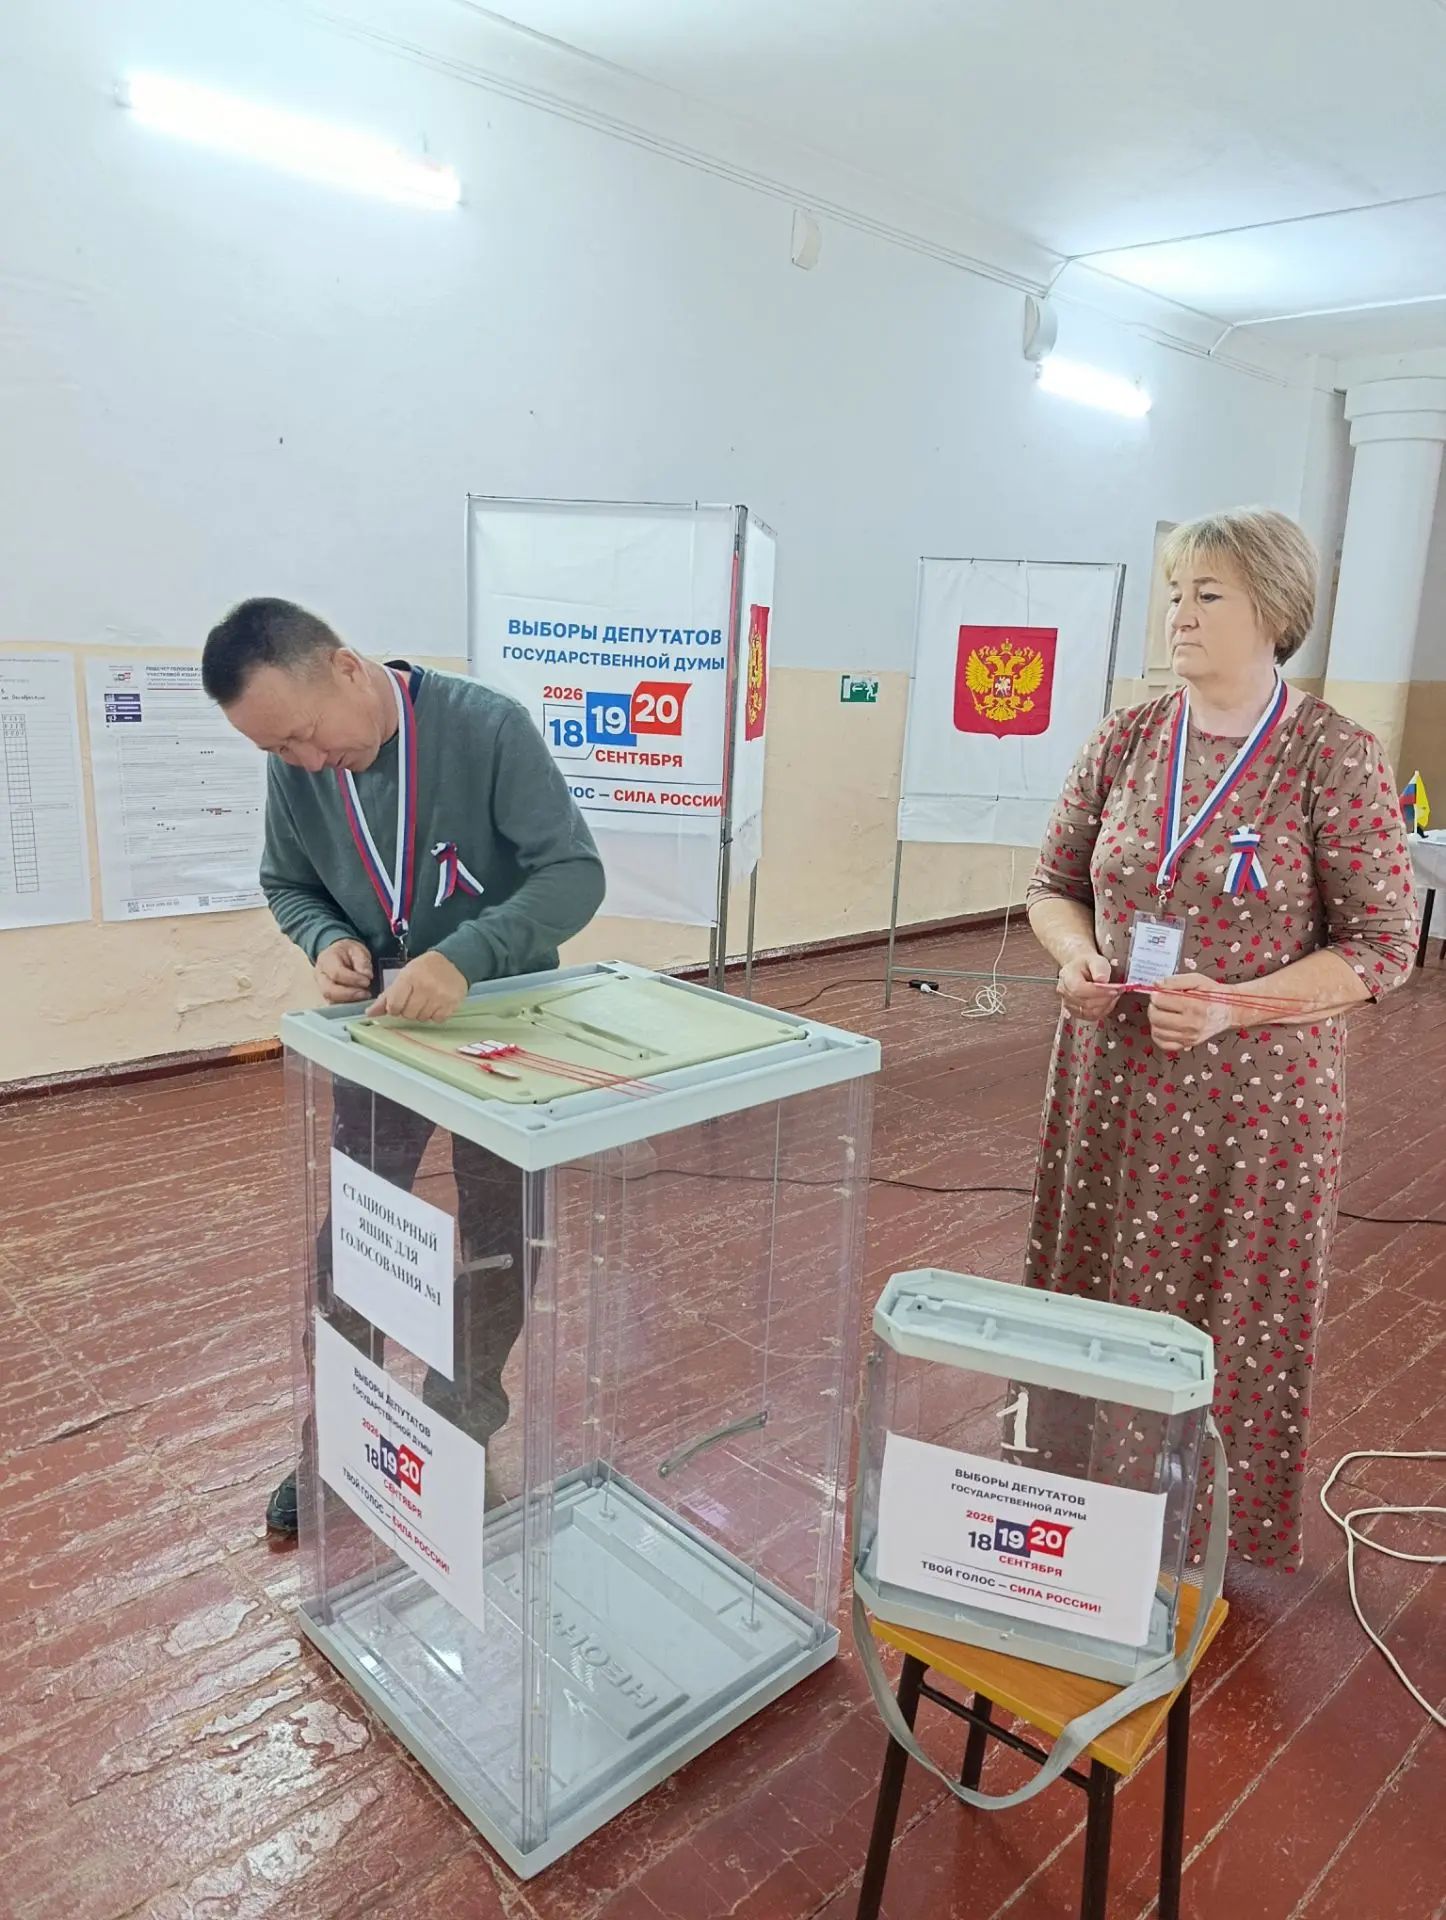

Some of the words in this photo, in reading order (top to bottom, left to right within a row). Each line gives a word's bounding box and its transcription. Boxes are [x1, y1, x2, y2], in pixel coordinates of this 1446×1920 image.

[508, 619, 597, 640] ВЫБОРЫ
[602, 626, 722, 646] ДЕПУТАТОВ
[503, 646, 670, 669] ГОСУДАРСТВЕННОЙ
[673, 656, 725, 672] ДУМЫ
[543, 686, 583, 700] 2026
[549, 719, 584, 747] 18
[591, 705, 627, 735] 19
[635, 694, 679, 723] 20
[595, 750, 683, 767] СЕНТЯБРЯ
[614, 789, 656, 804] СИЛА
[342, 1183, 438, 1252] СТАЦИОНАРНЫЙ
[359, 1217, 394, 1250] ЯЩИК
[394, 1240, 419, 1265] ДЛЯ
[340, 1227, 422, 1292] ГОЛОСОВАНИЯ
[424, 1284, 441, 1306] №1
[353, 1383, 411, 1438] ГОСУДАРСТВЕННОЙ
[412, 1435, 433, 1456] ДУМЫ
[354, 1367, 384, 1400] ВЫБОРЫ
[386, 1394, 431, 1437] ДЕПУТАТОВ
[362, 1418, 379, 1438] 2026
[996, 1391, 1039, 1453] 1
[364, 1443, 380, 1471] 18
[382, 1447, 398, 1475] 19
[400, 1452, 420, 1484] 20
[343, 1467, 361, 1489] ТВОЙ
[361, 1486, 384, 1514] ГОЛОС
[392, 1515, 413, 1541] СИЛА
[384, 1479, 422, 1519] СЕНТЯБРЯ
[950, 1483, 1053, 1513] ГОСУДАРСТВЕННОЙ
[1054, 1507, 1087, 1521] ДУМЫ
[955, 1468, 1009, 1489] ВЫБОРЫ
[1011, 1482, 1086, 1506] ДЕПУТАТОВ
[966, 1510, 994, 1524] 2026
[967, 1531, 992, 1551] 18
[998, 1528, 1025, 1549] 19
[1030, 1527, 1063, 1550] 20
[921, 1560, 953, 1576] ТВОЙ
[956, 1570, 996, 1587] ГОЛОС
[1009, 1583, 1043, 1599] СИЛА
[998, 1555, 1063, 1577] СЕНТЯБРЯ
